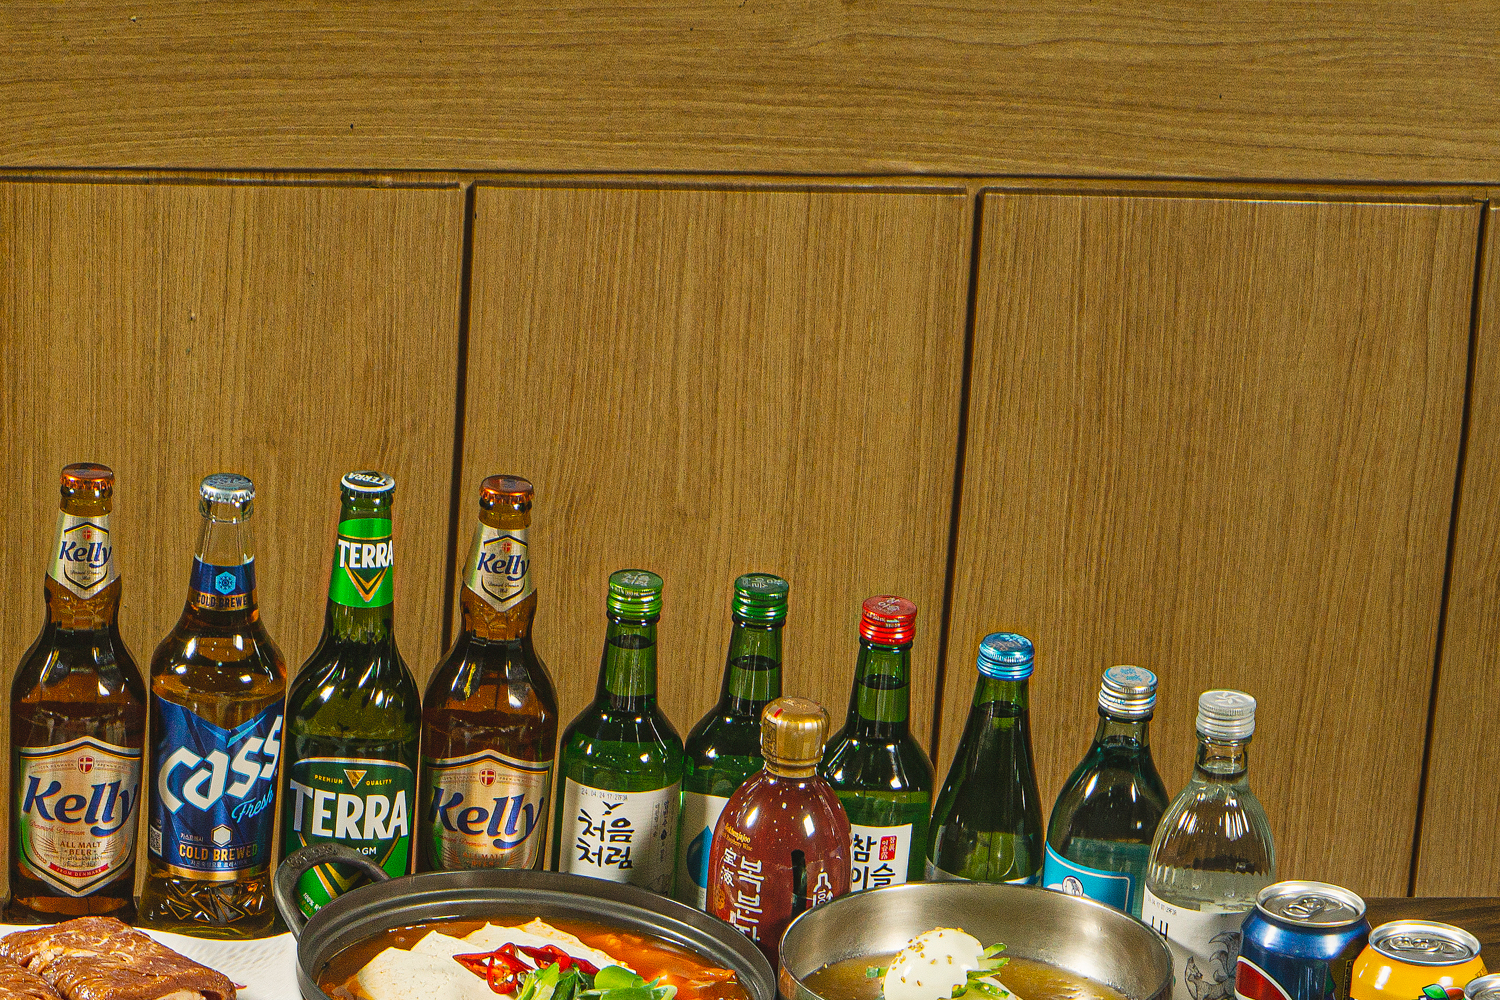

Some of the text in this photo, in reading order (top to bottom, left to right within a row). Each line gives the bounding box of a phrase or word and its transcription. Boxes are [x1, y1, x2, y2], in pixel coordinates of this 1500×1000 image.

[59, 541, 112, 568] Kelly
[338, 539, 394, 569] TERRA
[477, 552, 530, 581] Kelly
[314, 774, 392, 786] PREMIUM QUALITY
[22, 775, 138, 838] Kelly
[231, 783, 274, 823] Fresh
[290, 779, 408, 840] TERRA
[427, 786, 545, 850] Kelly
[577, 808, 635, 843] 처음
[60, 841, 102, 849] ALL MALT
[179, 844, 258, 862] COLD BREWED
[462, 851, 505, 860] ALL MALT
[576, 837, 633, 869] 처럼
[853, 833, 877, 863] 참
